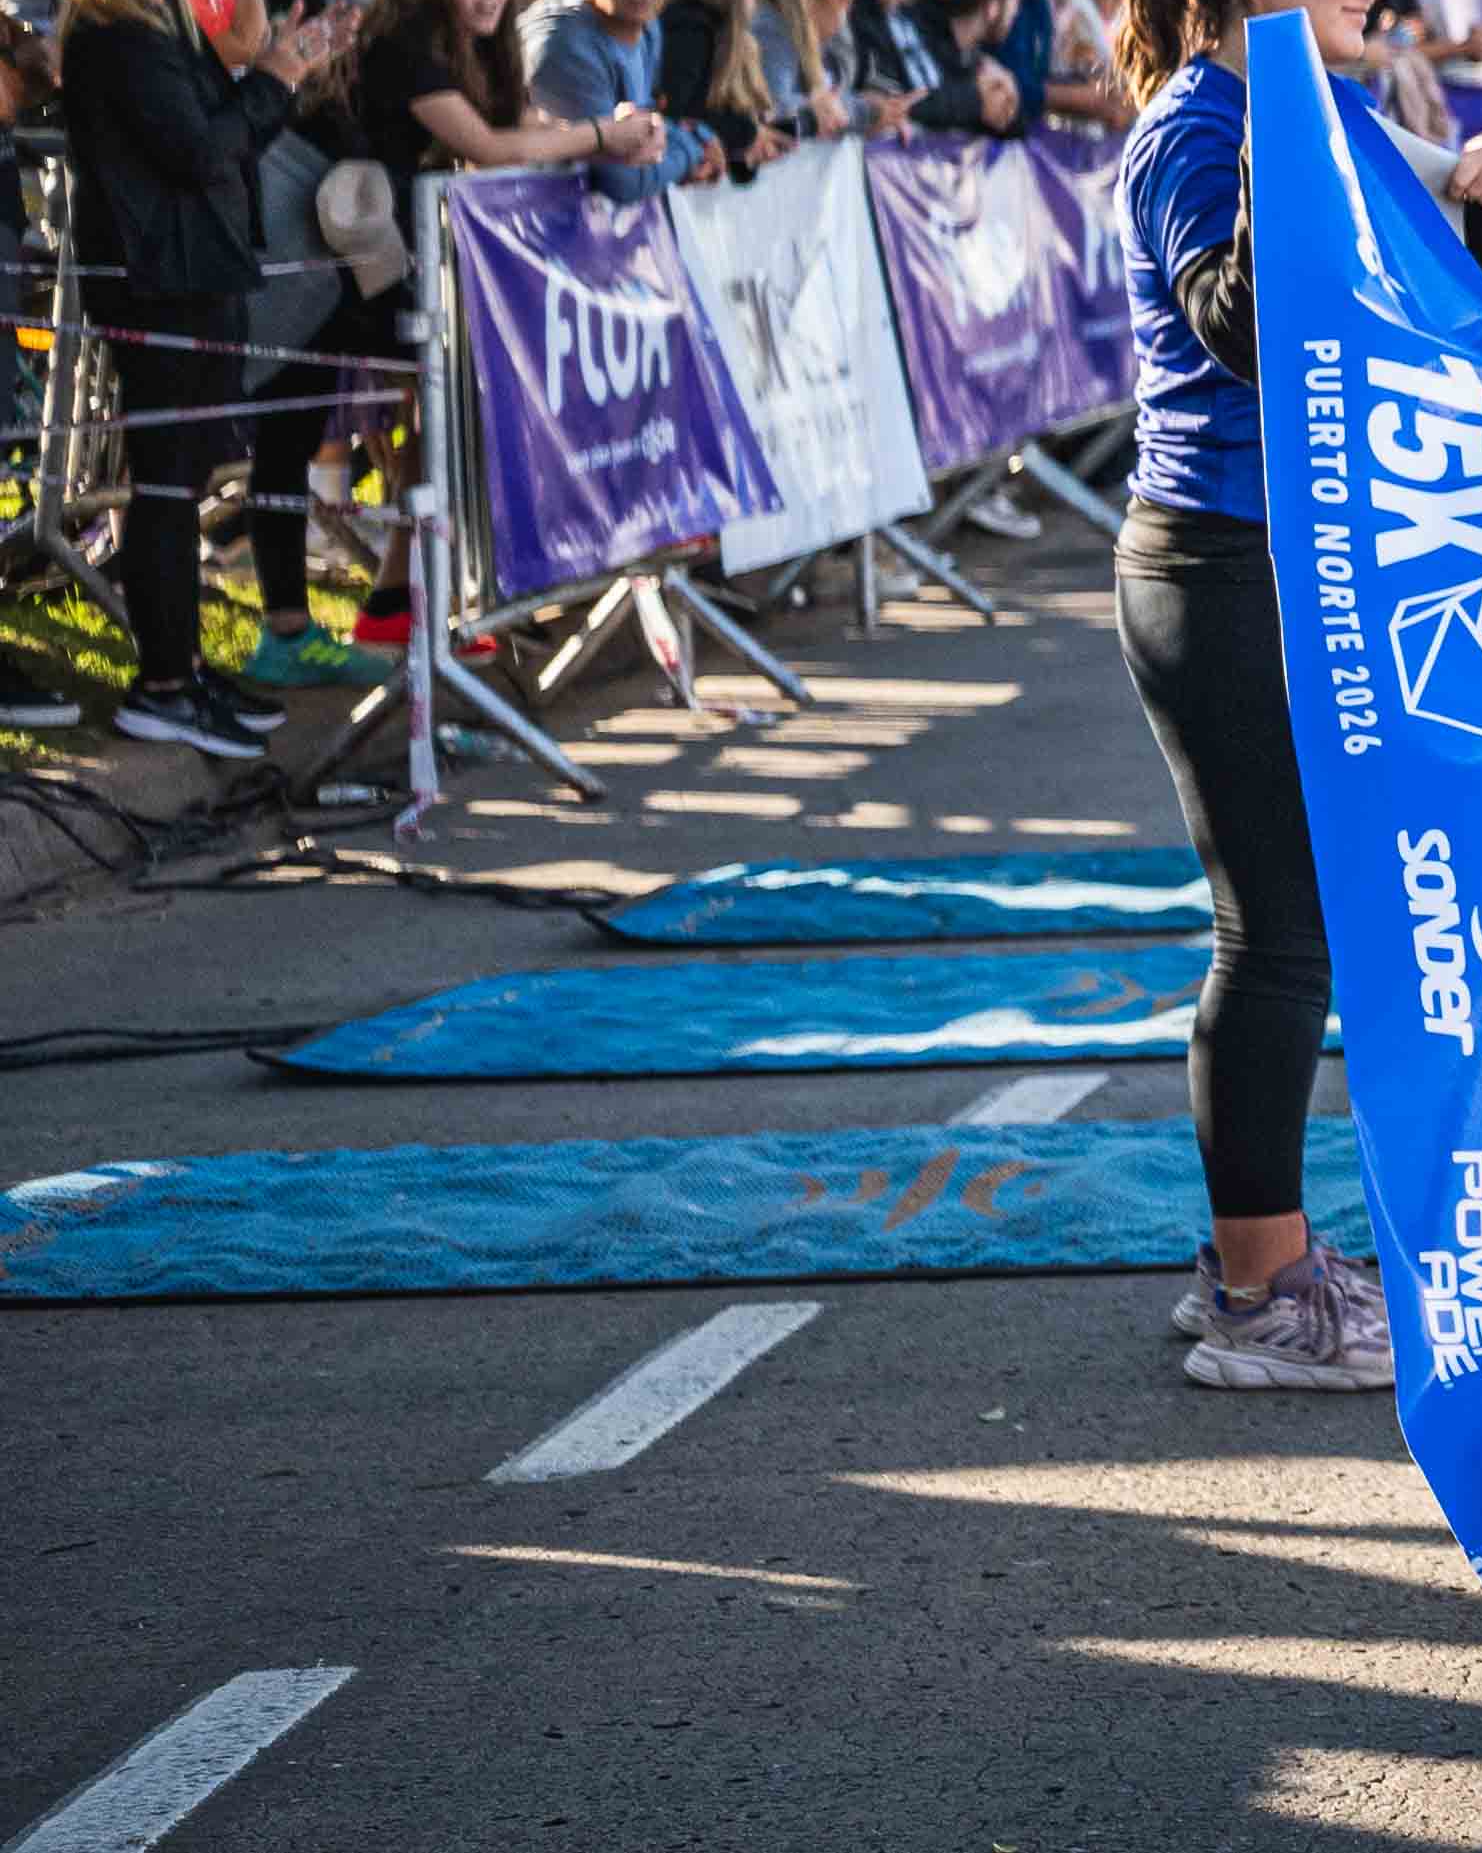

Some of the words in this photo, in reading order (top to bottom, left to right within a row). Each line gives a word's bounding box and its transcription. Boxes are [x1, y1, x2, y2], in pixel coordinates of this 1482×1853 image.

[1303, 339, 1352, 505] PUERTO
[1313, 523, 1365, 653] NORTE
[1330, 665, 1383, 757] 2026
[1418, 1250, 1479, 1384] ADE
